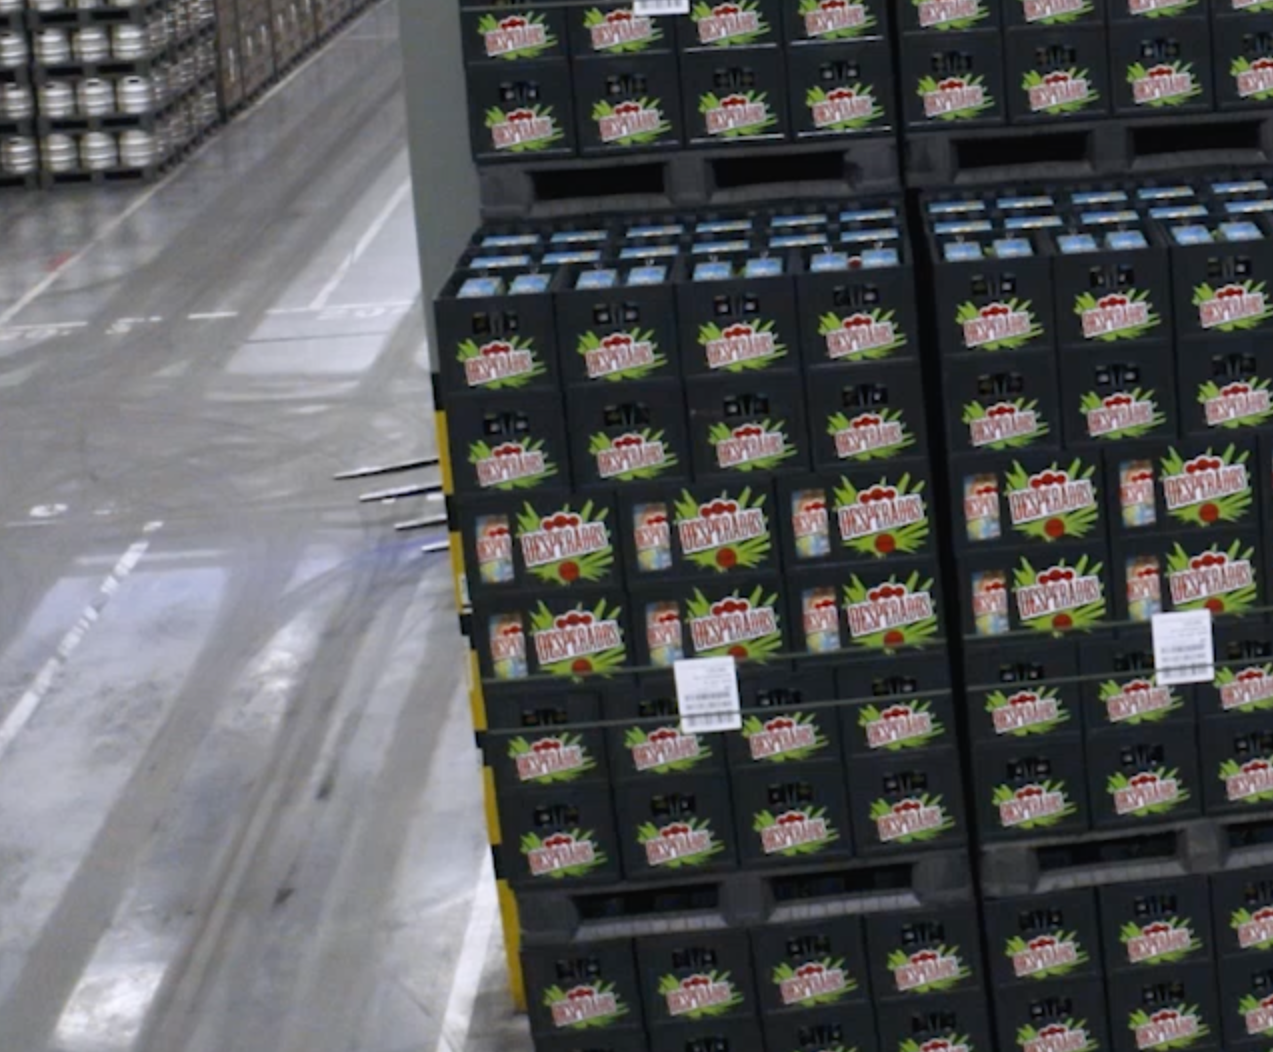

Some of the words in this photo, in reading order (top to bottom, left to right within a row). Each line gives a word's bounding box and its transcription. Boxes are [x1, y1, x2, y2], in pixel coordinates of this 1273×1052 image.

[1009, 481, 1094, 522] DESPERADOS
[1165, 466, 1247, 506] DESPERADOS
[678, 509, 765, 552] DESPERADOS
[838, 496, 923, 537] DESPERADOS
[522, 522, 608, 565] DESPERADOS
[1018, 577, 1100, 617] DESPERADOS
[1170, 561, 1252, 601] DESPERADOS
[692, 608, 774, 648] DESPERADOS
[847, 594, 932, 635] DESPERADOS
[535, 621, 620, 662] DESPERADOS
